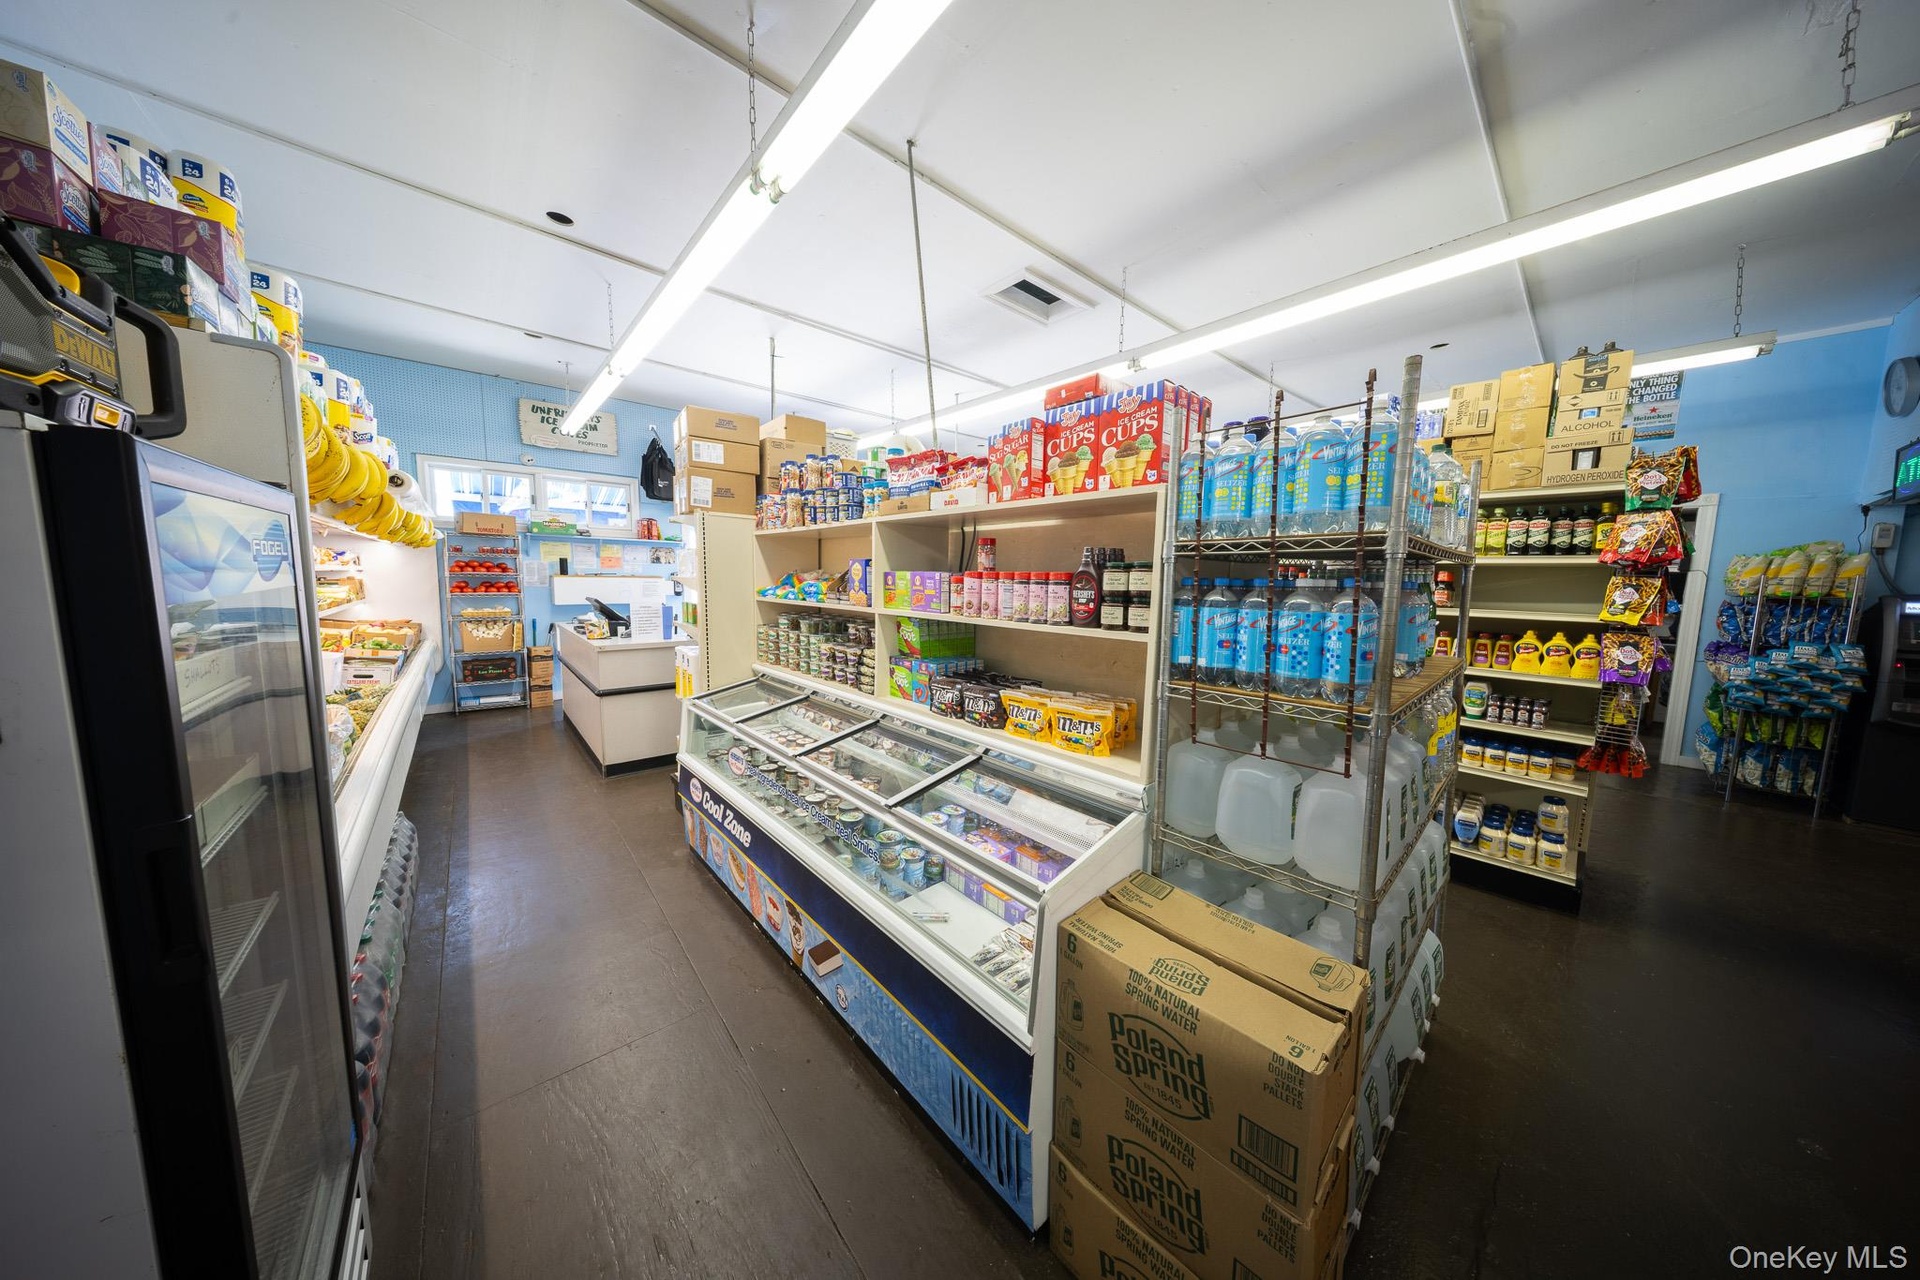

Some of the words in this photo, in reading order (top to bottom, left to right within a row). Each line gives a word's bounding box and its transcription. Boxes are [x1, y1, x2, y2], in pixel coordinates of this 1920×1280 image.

[184, 167, 200, 177] 24
[252, 279, 268, 289] 24
[1629, 379, 1646, 388] NLY
[1649, 375, 1679, 386] THING
[1632, 383, 1678, 396] CHANGED
[1643, 391, 1676, 403] BOTTLE
[540, 416, 558, 426] ICE
[1118, 415, 1131, 427] ICE
[1131, 406, 1158, 421] CREAM
[1561, 420, 1615, 433] ALCOHOL
[1633, 413, 1673, 422] Heineken
[1060, 429, 1071, 438] ICE
[1071, 421, 1095, 436] CREAM
[1101, 414, 1159, 447] CUPS
[1003, 434, 1029, 454] SUGAR
[1047, 428, 1096, 457] CUPS
[1547, 472, 1585, 484] HYDROGEN
[1586, 470, 1624, 482] PEROXIDE
[1896, 456, 1920, 488] AT
[253, 539, 288, 556] FOGEL
[702, 792, 724, 824] Cool
[724, 811, 751, 848] Zone
[835, 821, 851, 844] Real
[851, 834, 880, 864] Smiles.
[1067, 920, 1098, 944] NATURAL
[1075, 917, 1098, 935] WATER
[1067, 932, 1078, 954] 6
[1097, 930, 1124, 949] SPRING
[1097, 941, 1118, 954] 100%
[1149, 965, 1208, 997] Poland
[1152, 957, 1211, 986] Spring
[1128, 968, 1153, 993] 100%
[1154, 986, 1201, 1022] NATURAL
[1125, 983, 1160, 1014] SPRING
[1161, 1003, 1199, 1036] WATER
[1108, 1012, 1207, 1088] Poland
[1285, 1035, 1311, 1051] GALLON
[1288, 1045, 1304, 1058] 6
[1065, 1051, 1076, 1072] 6
[1271, 1051, 1284, 1064] DO
[1286, 1058, 1305, 1077] NOT
[1112, 1042, 1212, 1120] Spring
[1268, 1062, 1305, 1087] DOUBLE
[1157, 1089, 1182, 1110] 1845
[1263, 1083, 1304, 1110] PALLETS
[1274, 1077, 1304, 1100] STACK
[1124, 1110, 1158, 1141] SPRING
[1160, 1135, 1195, 1171] WATER
[1125, 1097, 1150, 1121] 100%
[1151, 1116, 1197, 1160] NATURAL
[1058, 1161, 1067, 1183] 6
[1106, 1134, 1203, 1222] Poland
[1109, 1166, 1206, 1255] Spring
[1265, 1203, 1277, 1216] DO
[1279, 1211, 1298, 1233] NOT
[1261, 1213, 1297, 1243] DOUBLE
[1268, 1227, 1297, 1253] STACK
[1115, 1230, 1148, 1265] SPRING
[1116, 1216, 1140, 1244] 100%
[1142, 1238, 1186, 1280] NATURAL
[1257, 1229, 1296, 1265] PALLETS
